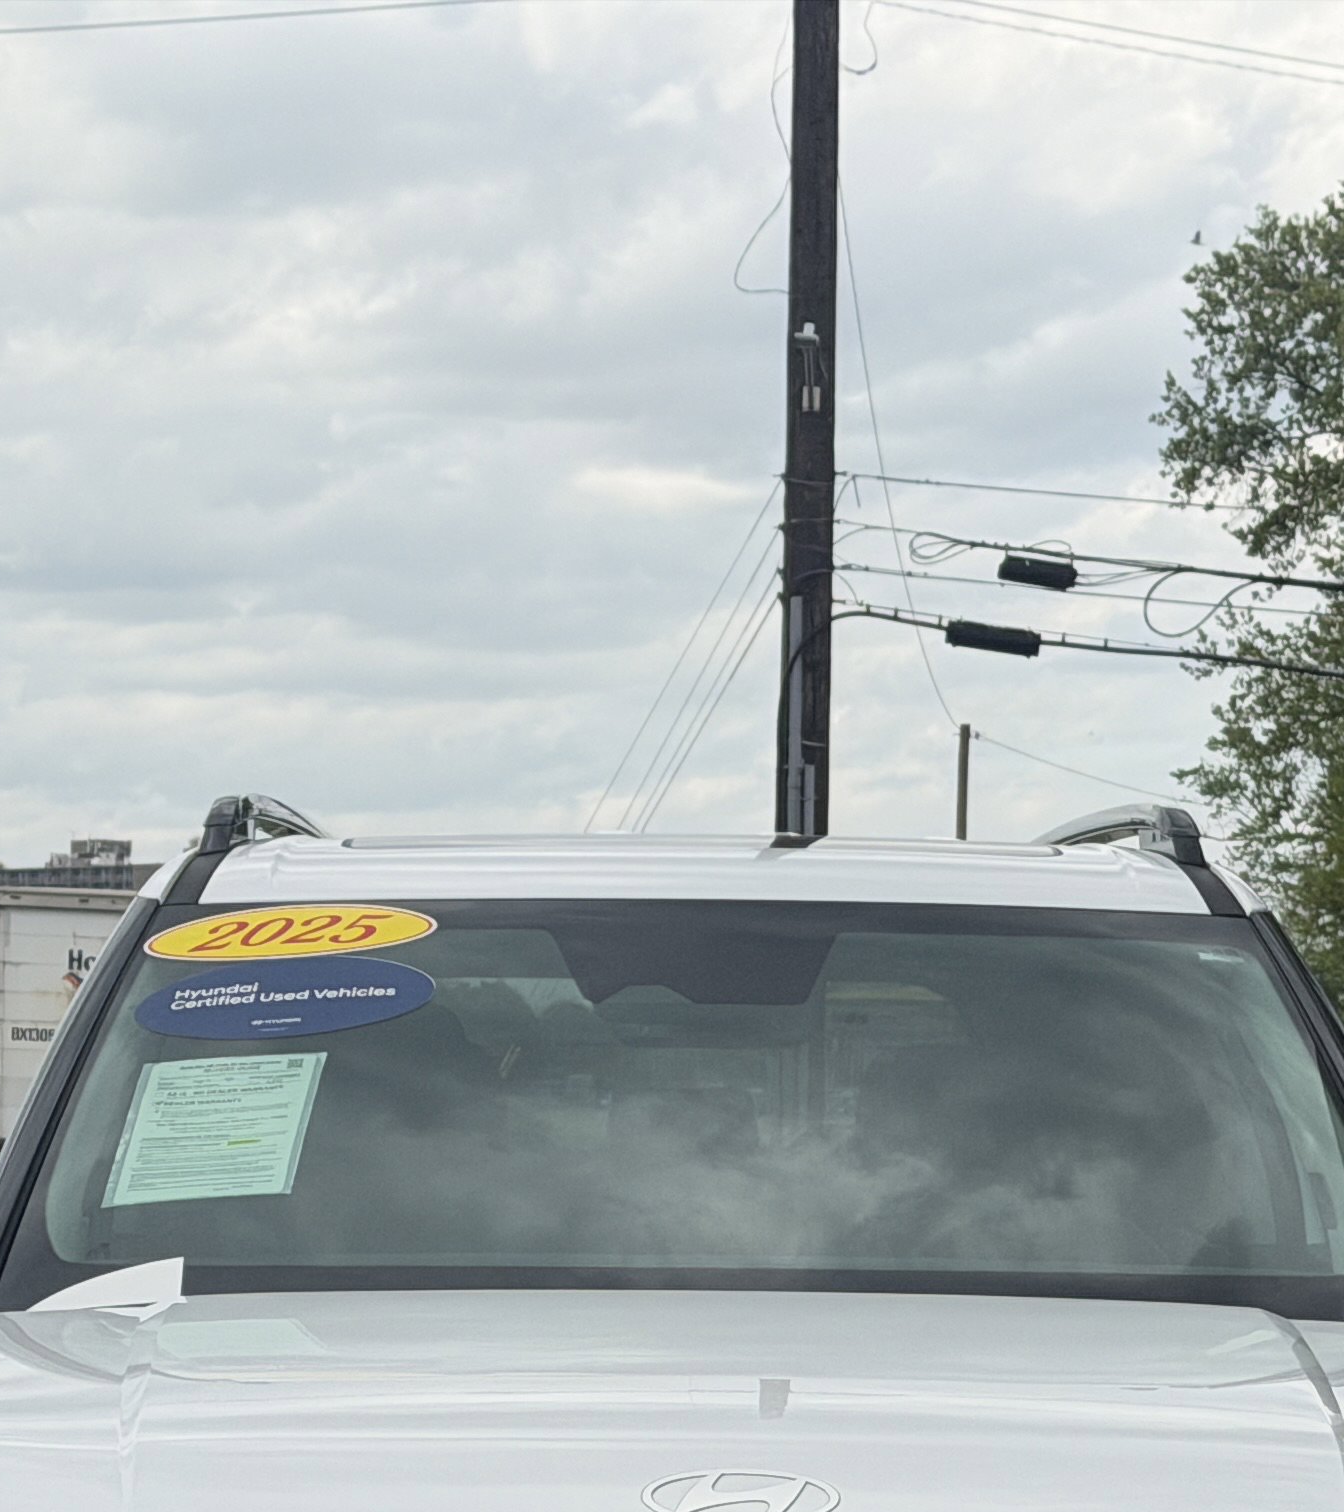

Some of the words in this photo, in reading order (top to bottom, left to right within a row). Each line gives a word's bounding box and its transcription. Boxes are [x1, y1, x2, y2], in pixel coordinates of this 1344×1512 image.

[186, 914, 395, 953] 2025
[170, 993, 256, 1011] Certified
[259, 989, 310, 1003] Used
[313, 986, 397, 1000] Vehicles
[174, 982, 260, 1000] Hyundai
